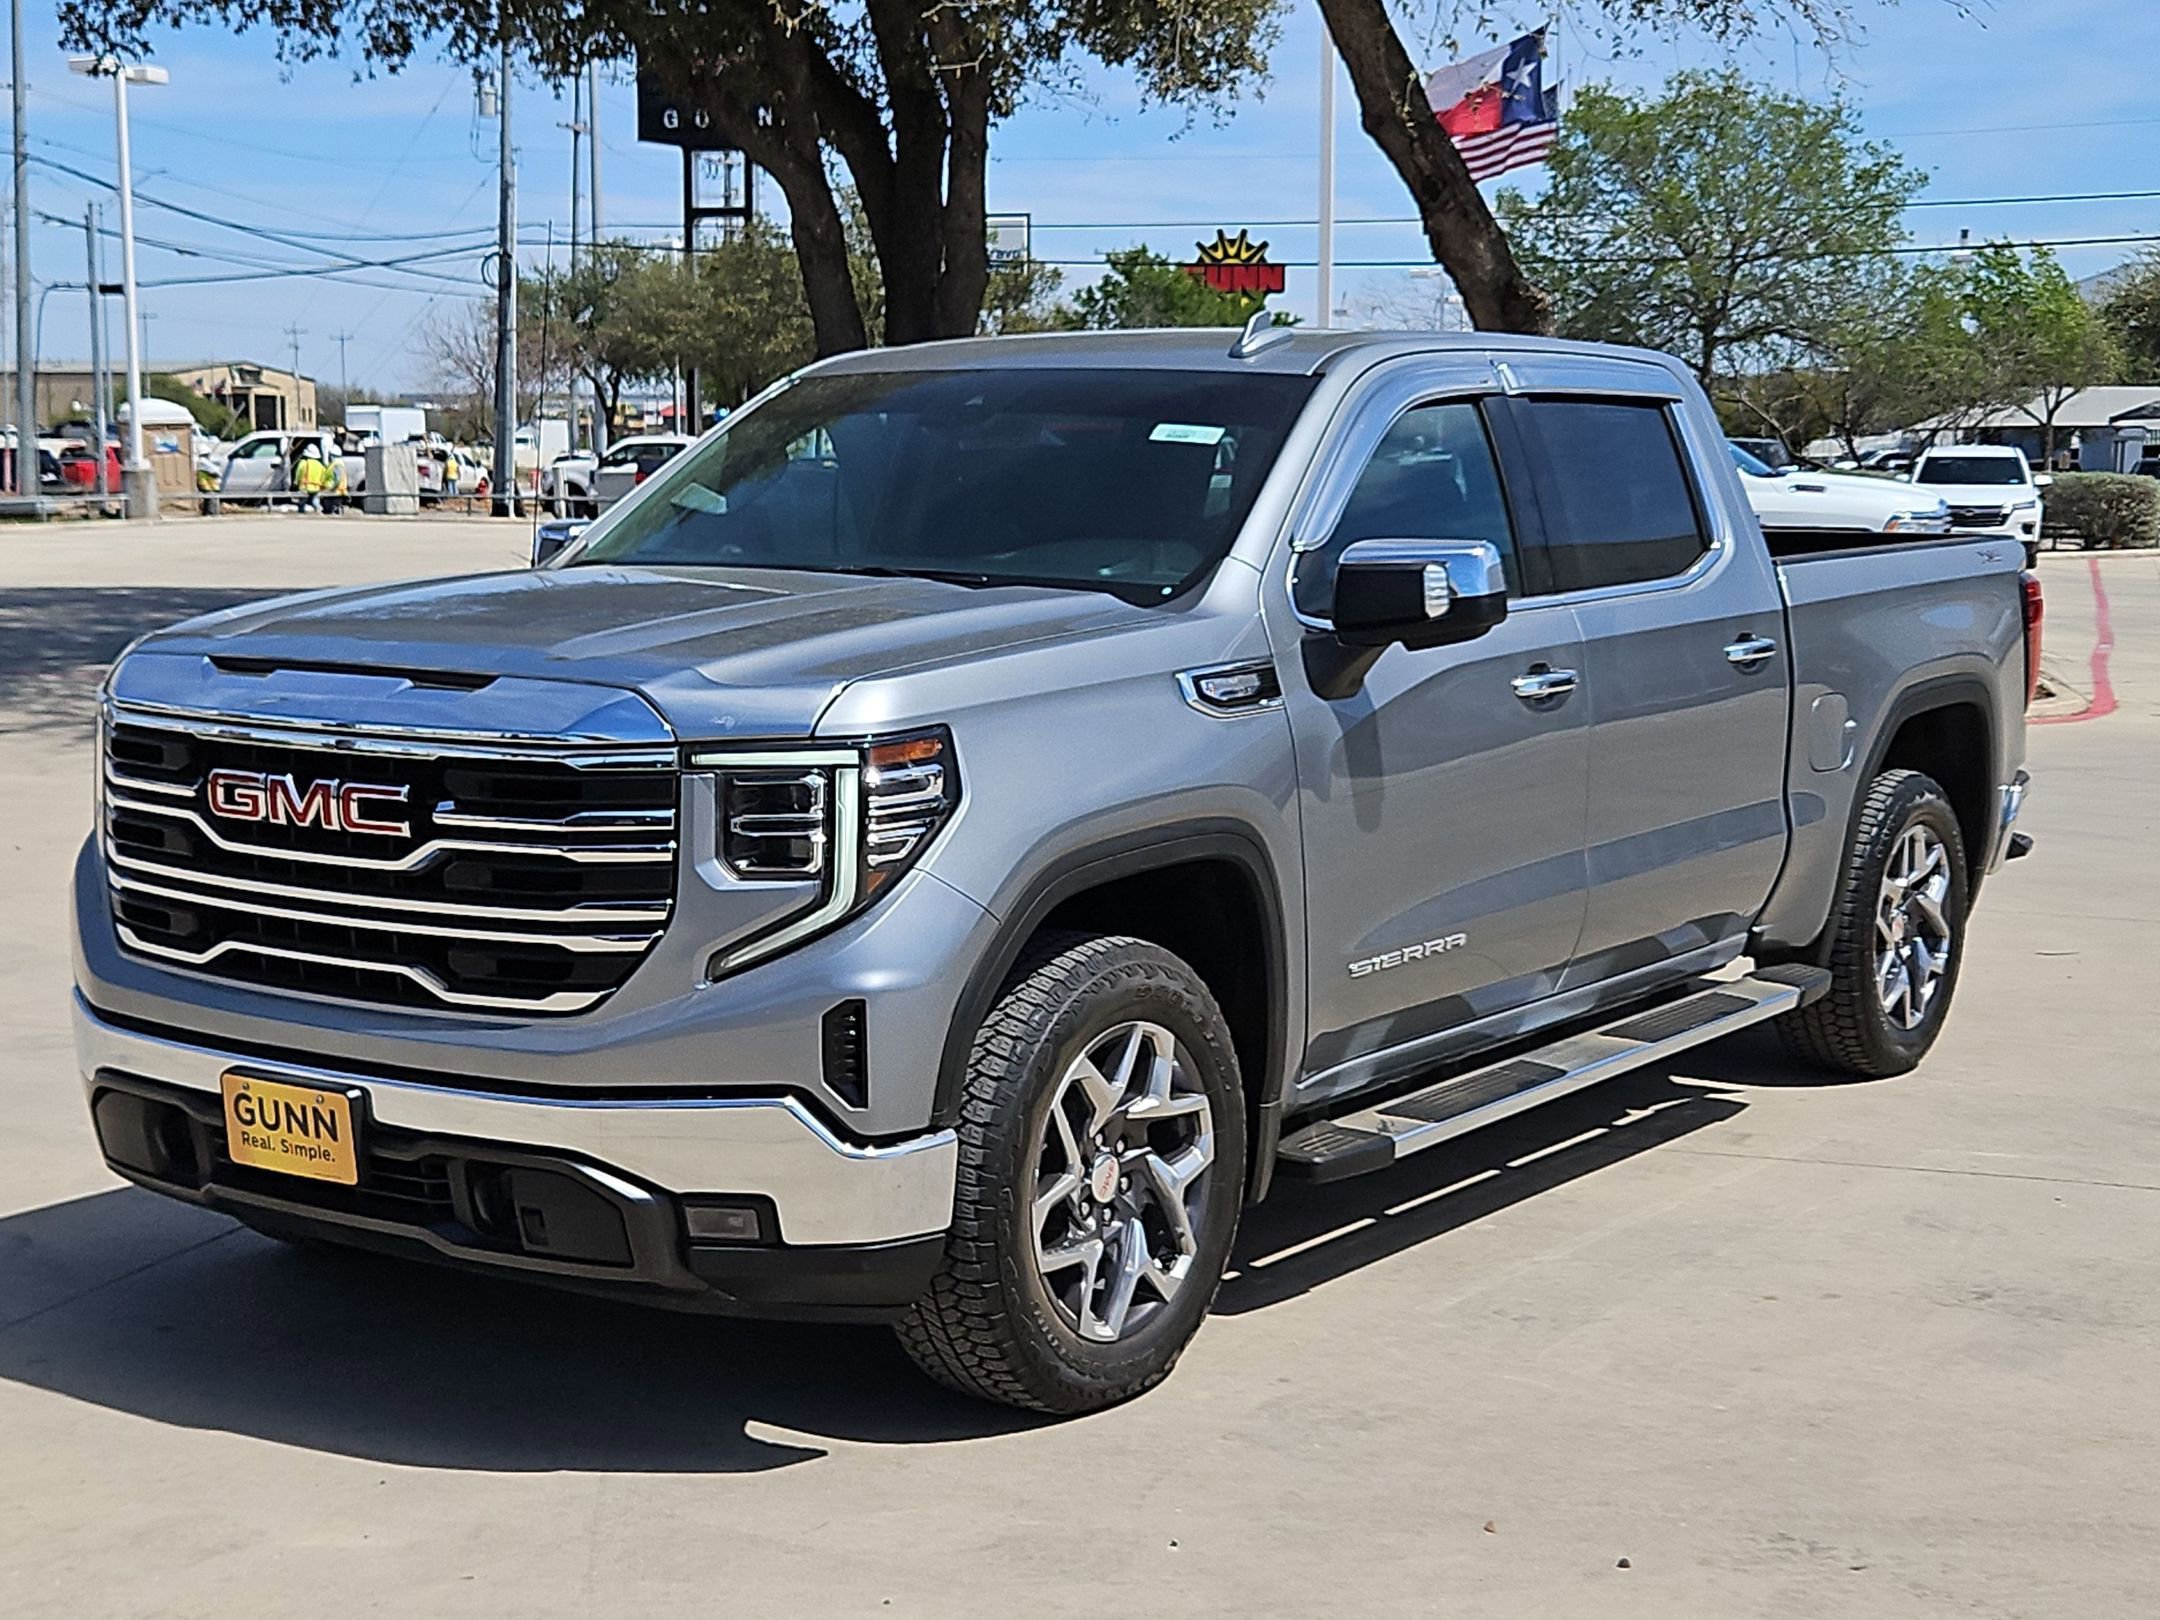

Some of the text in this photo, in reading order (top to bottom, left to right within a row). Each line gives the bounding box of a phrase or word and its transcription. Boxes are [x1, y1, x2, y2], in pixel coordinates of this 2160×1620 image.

[663, 106, 773, 129] GUN
[207, 768, 412, 838] GMC
[1347, 932, 1468, 979] SIERRA
[233, 1092, 339, 1143] GUNN
[241, 1131, 336, 1163] Real. Simple.
